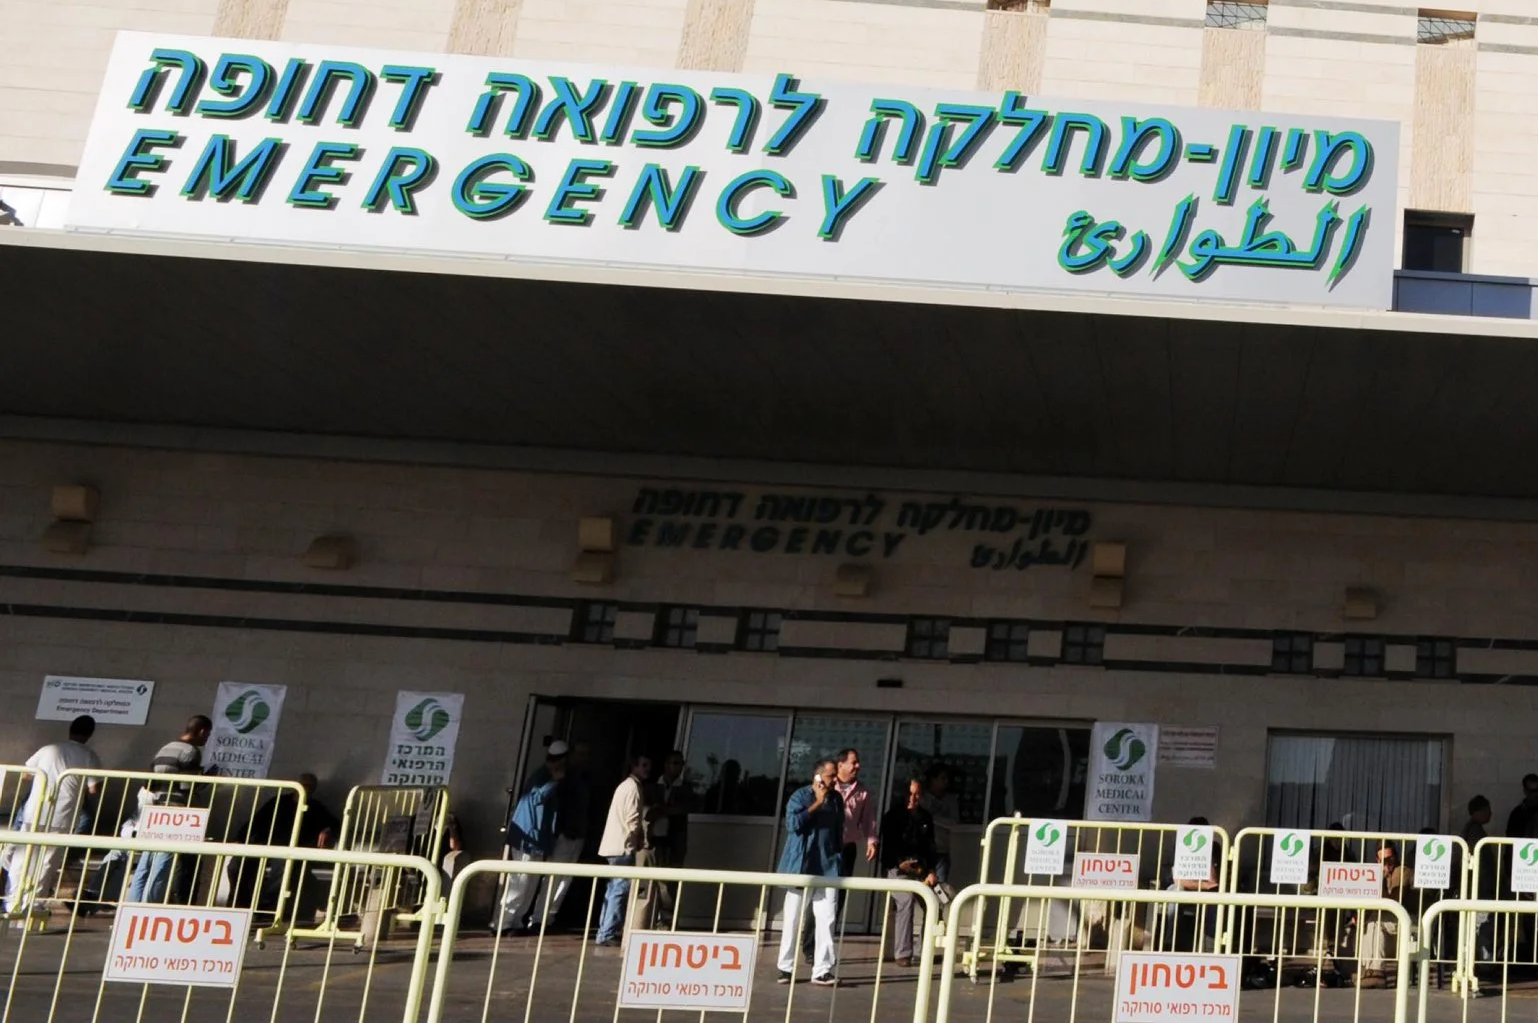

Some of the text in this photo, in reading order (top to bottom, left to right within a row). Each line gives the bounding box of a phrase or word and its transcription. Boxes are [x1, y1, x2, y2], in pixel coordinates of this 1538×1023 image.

[128, 49, 1372, 203] מיון-מחלקה לרפואה דחופה
[104, 128, 880, 241] EMERGENCY
[627, 519, 905, 557] EMERGENCY
[397, 745, 445, 756] המרכז
[392, 759, 445, 771] הרפואי
[1098, 774, 1145, 785] SOROKA
[1098, 804, 1140, 814] CENTER
[147, 812, 201, 829] ביטחון
[1080, 858, 1133, 876] ביטחון
[1326, 867, 1377, 884] ביטחון
[125, 915, 233, 949] ביטחון
[115, 955, 233, 973] מרכז רפואי סורוקה
[637, 942, 742, 976] ביטחון
[1129, 962, 1228, 995] ביטחון
[628, 981, 743, 997] מרכז רפואי סורוקה
[1122, 1001, 1231, 1016] מרכז רפואי סורוקה
